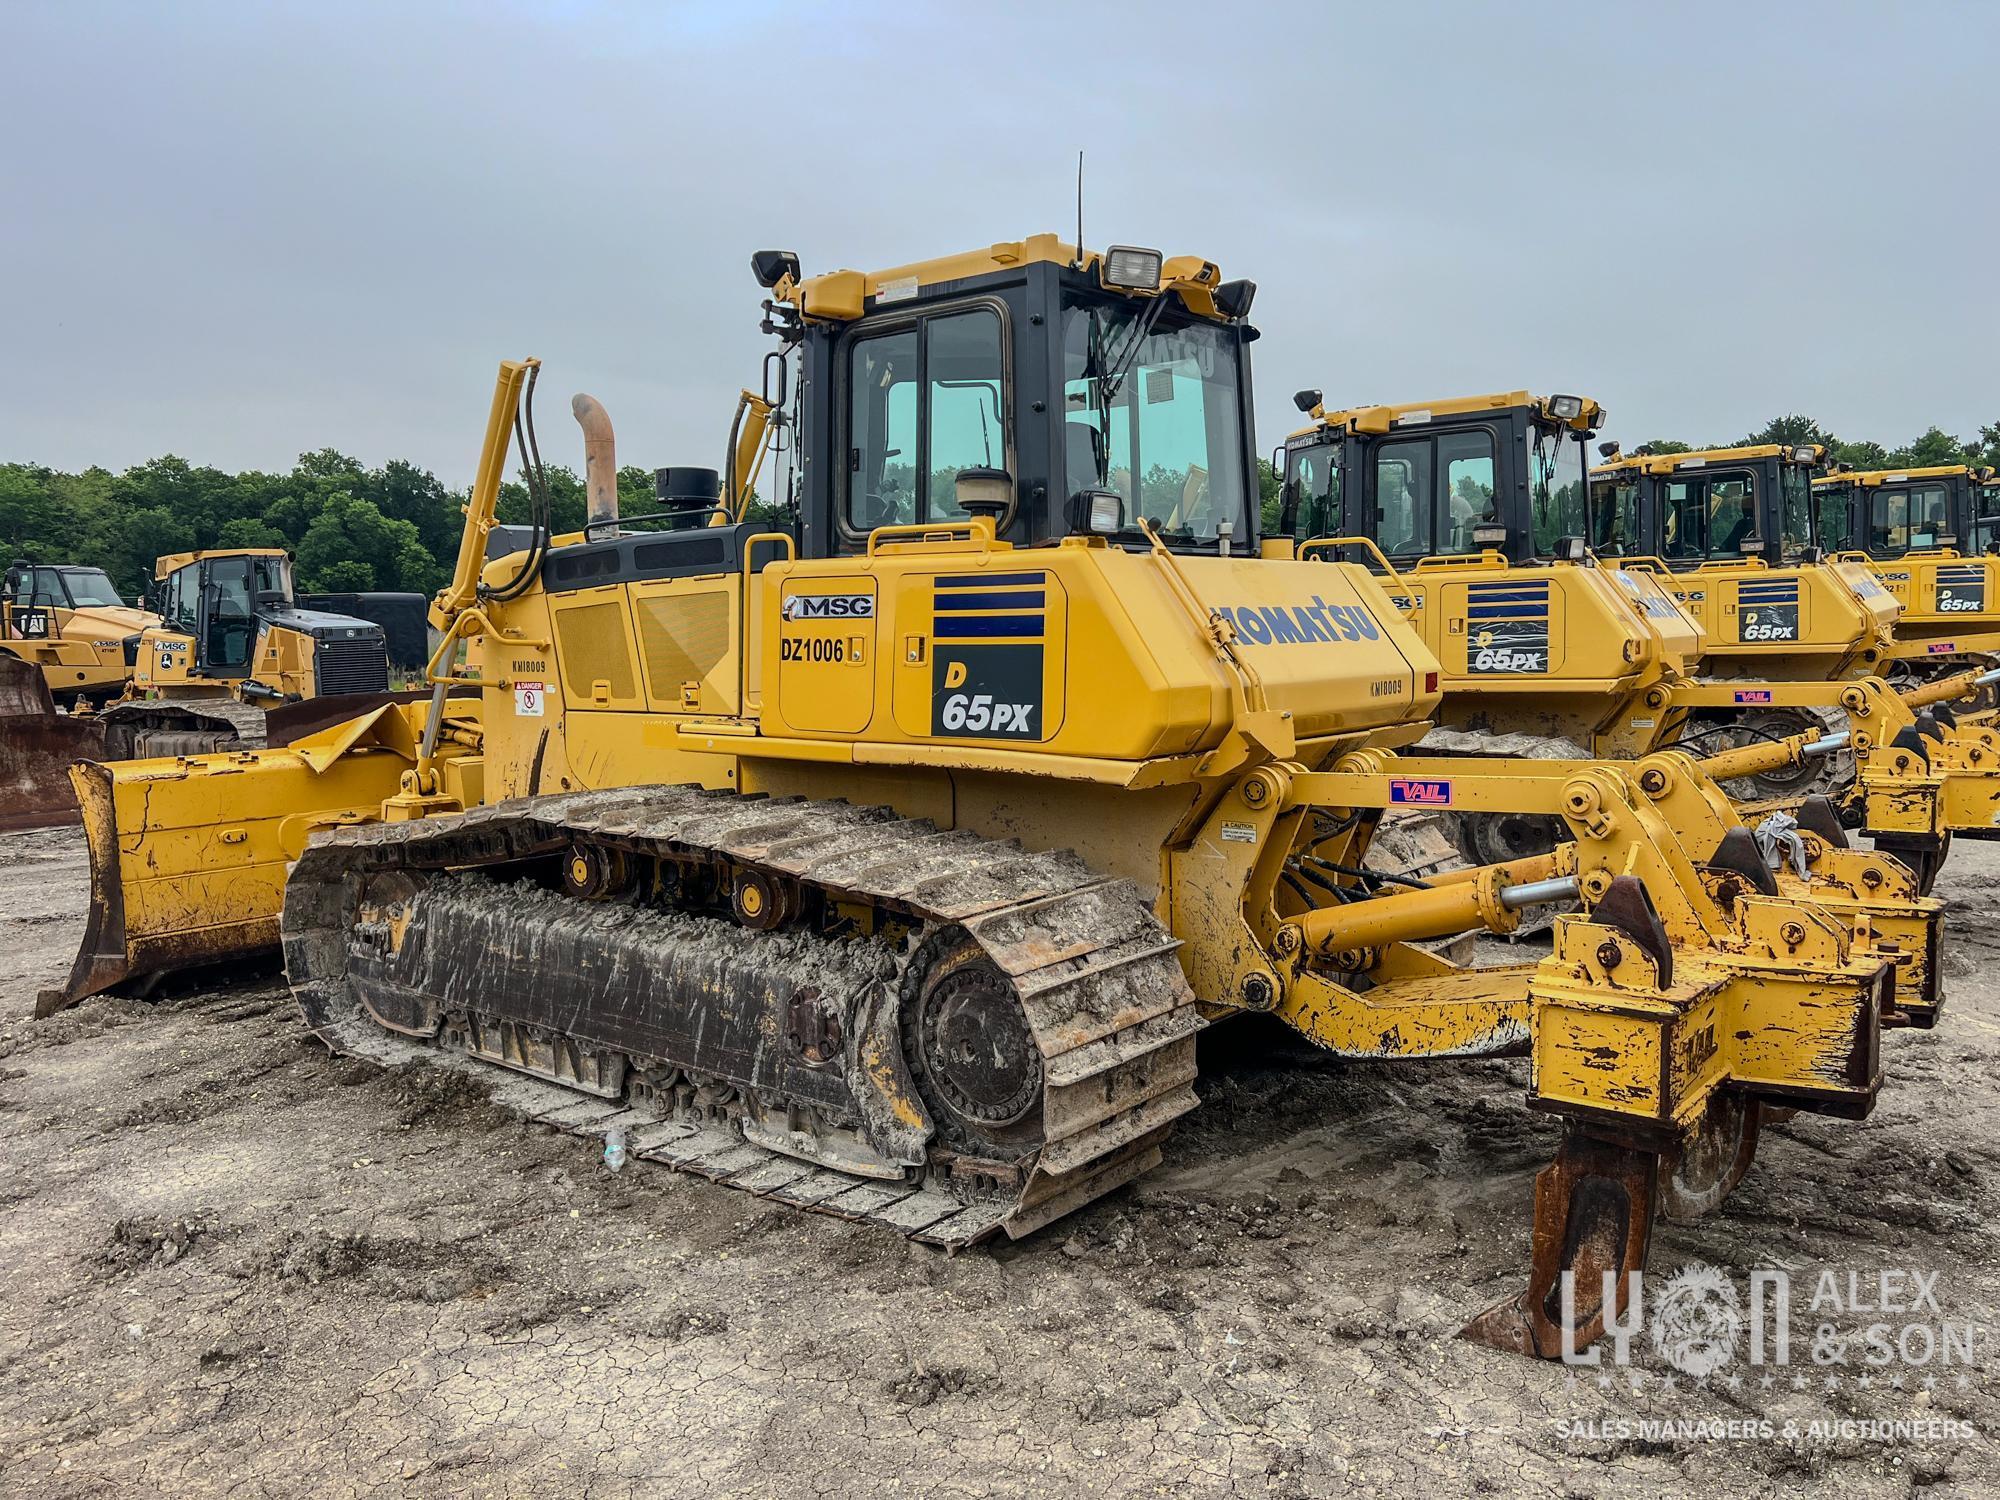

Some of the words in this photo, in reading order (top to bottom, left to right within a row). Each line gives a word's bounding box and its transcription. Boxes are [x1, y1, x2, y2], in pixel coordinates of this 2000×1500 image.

[1391, 596, 1422, 609] SG
[1941, 590, 1953, 600] D
[803, 597, 872, 616] MSG
[1940, 600, 1981, 612] 65PX
[1745, 612, 1758, 625] D
[1477, 631, 1493, 647] D
[1744, 624, 1795, 641] 65PX
[162, 643, 187, 651] MSG
[781, 638, 844, 662] DZ1006
[1475, 650, 1542, 671] 65PX
[944, 661, 967, 689] D
[1735, 692, 1770, 702] VAIL
[942, 693, 1034, 732] 65PX
[1393, 783, 1447, 802] VAIL
